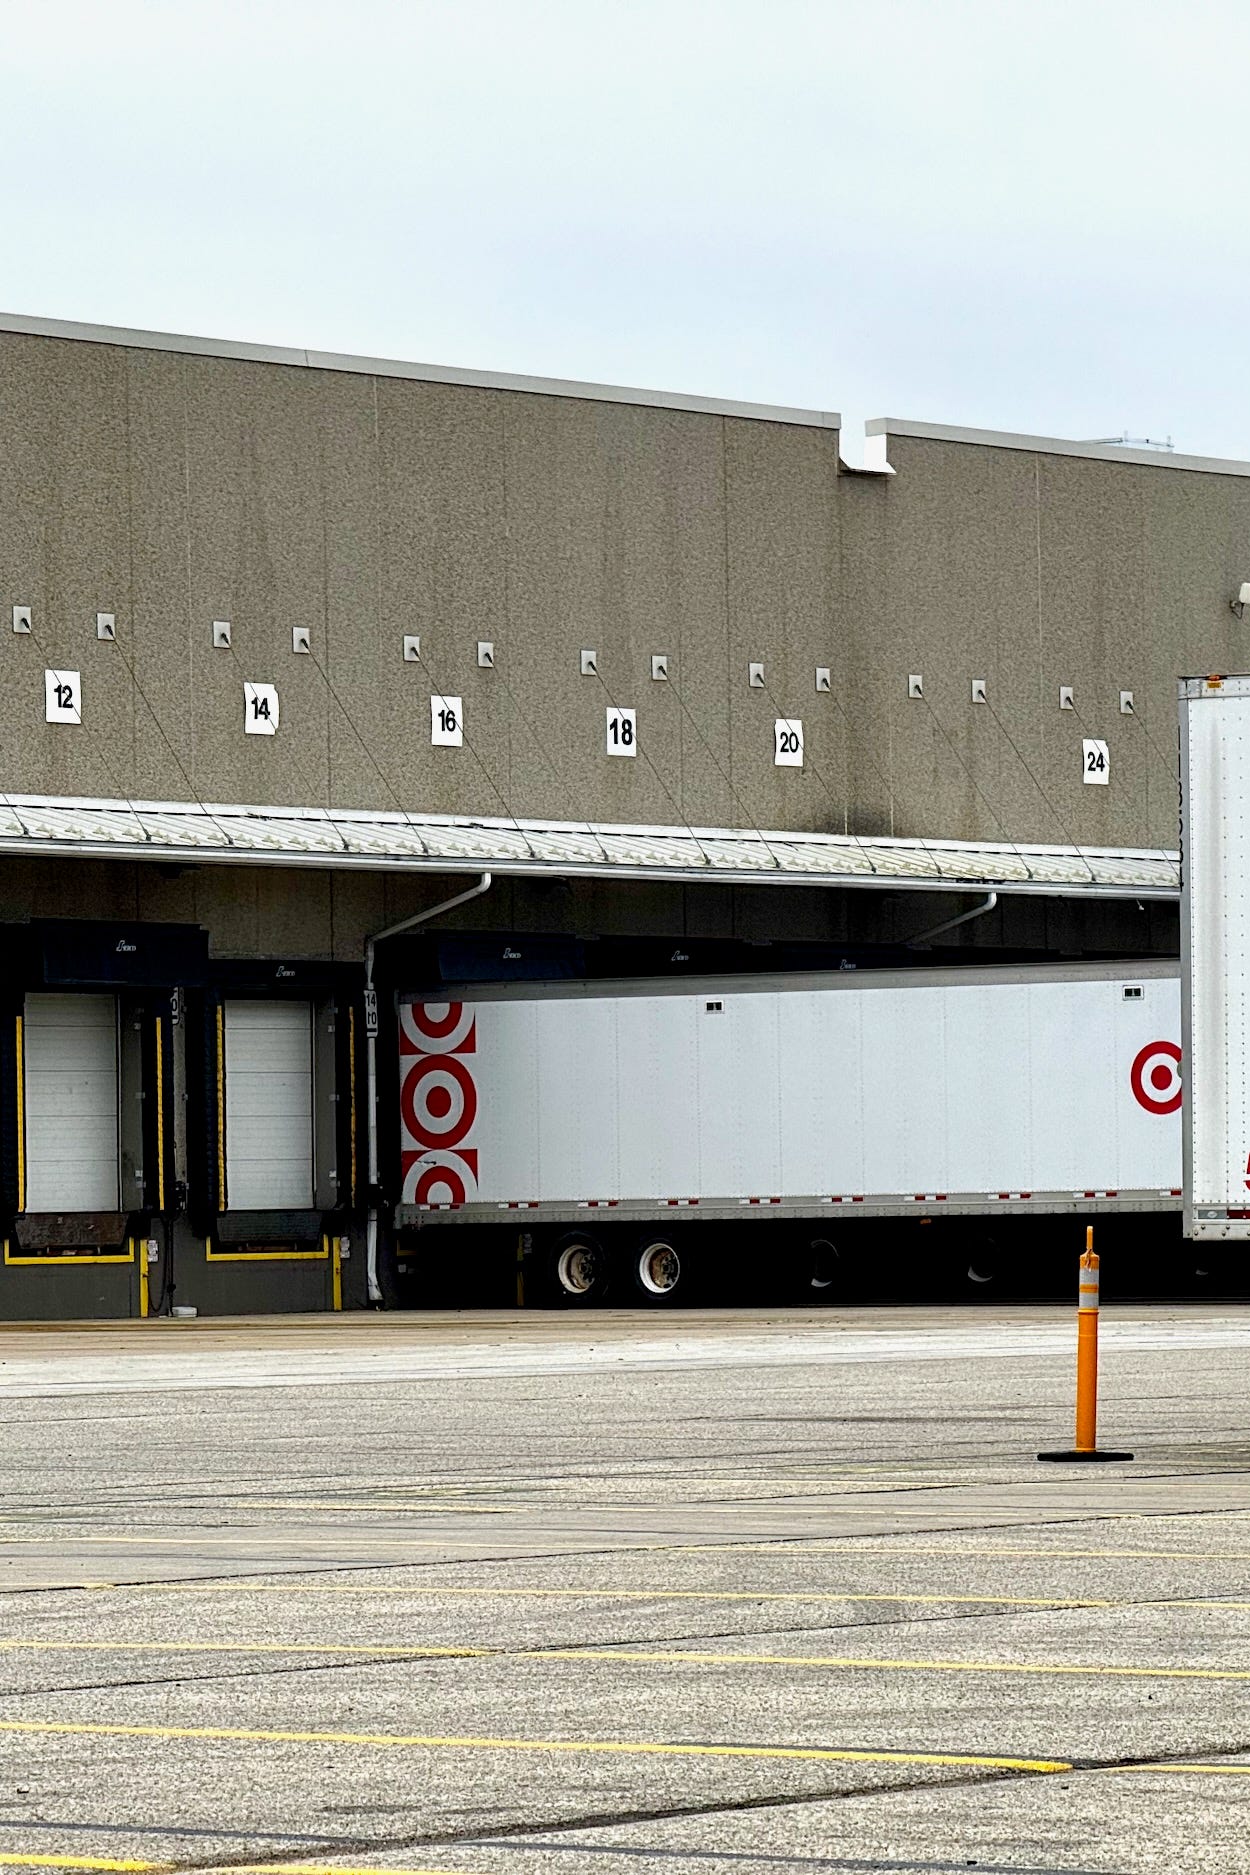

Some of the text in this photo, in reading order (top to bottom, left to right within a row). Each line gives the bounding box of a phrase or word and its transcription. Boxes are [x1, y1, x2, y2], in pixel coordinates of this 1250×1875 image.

[54, 684, 74, 708] 12
[251, 697, 271, 720] 14
[438, 709, 457, 732] 16
[609, 719, 633, 745] 18
[780, 732, 800, 752] 20
[1087, 751, 1106, 771] 24
[366, 993, 376, 1007] 14
